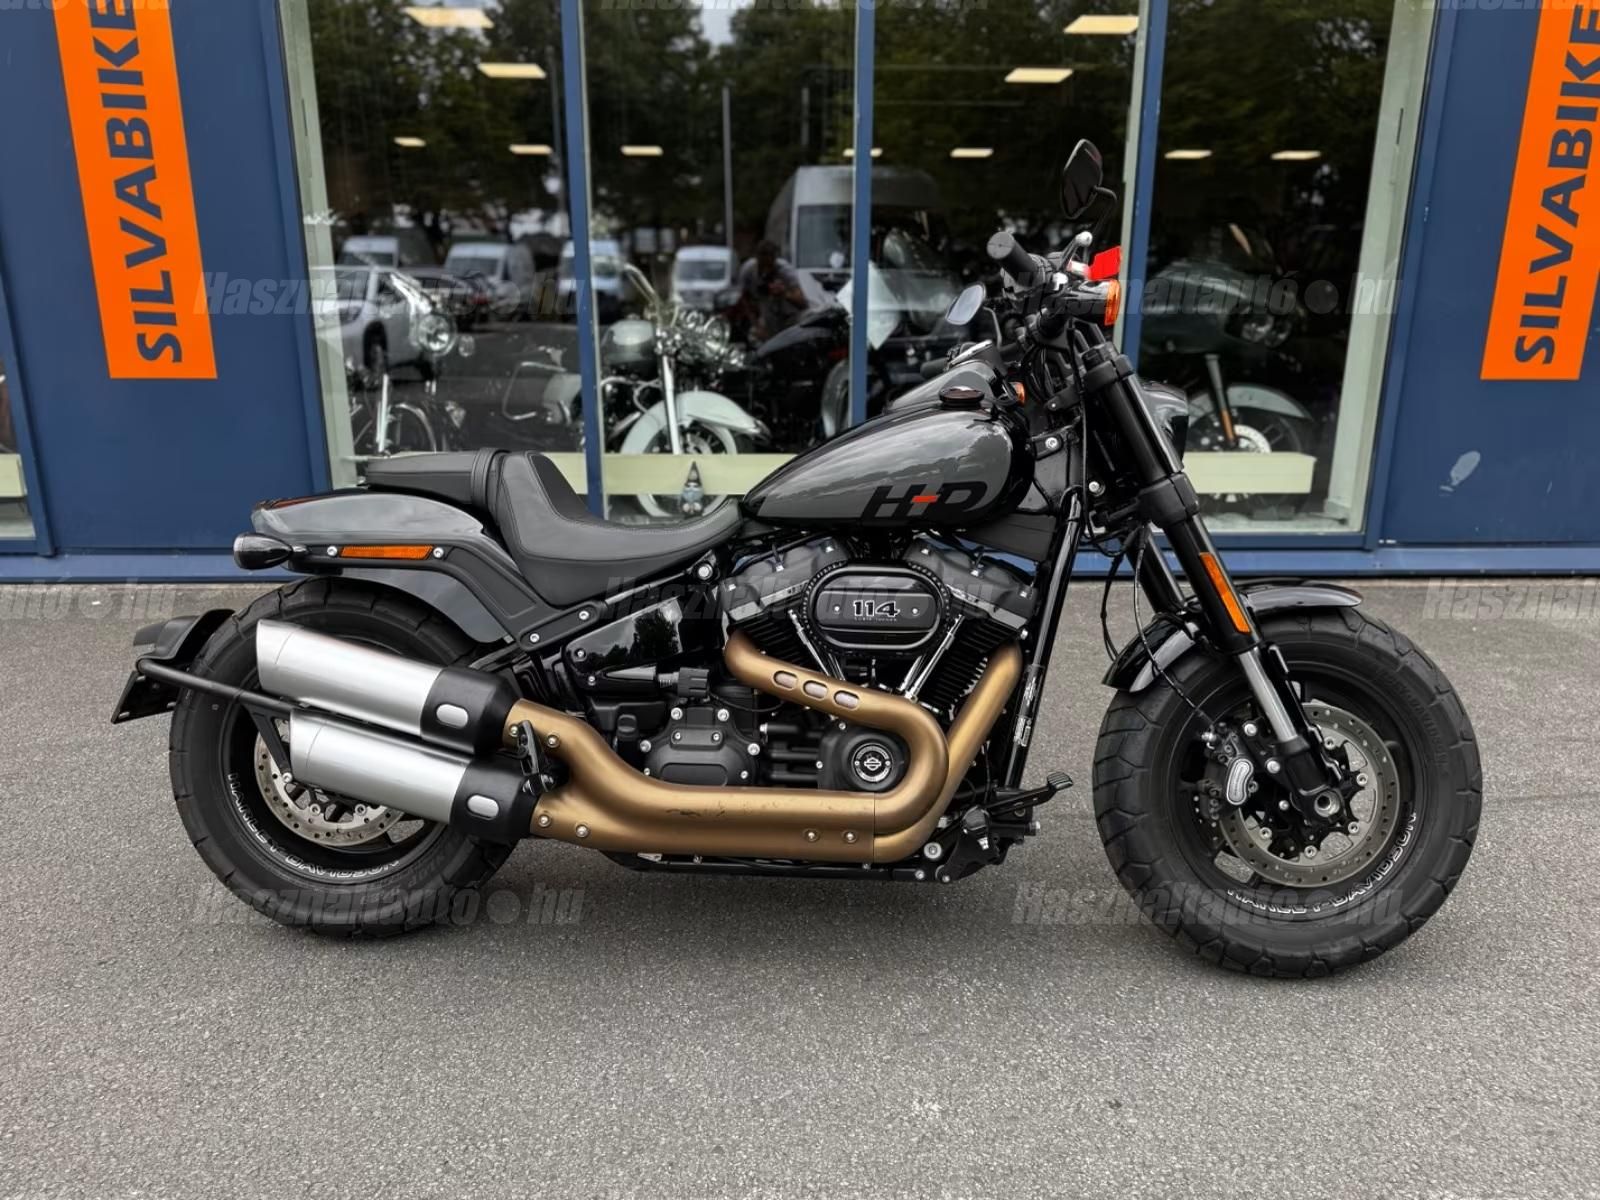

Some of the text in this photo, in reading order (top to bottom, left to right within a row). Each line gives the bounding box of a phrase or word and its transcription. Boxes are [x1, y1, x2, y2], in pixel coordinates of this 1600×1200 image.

[88, 0, 183, 363] SILVABIKE
[1514, 4, 1600, 365] SILVABIKE
[860, 479, 988, 520] H-D
[853, 599, 901, 618] 114
